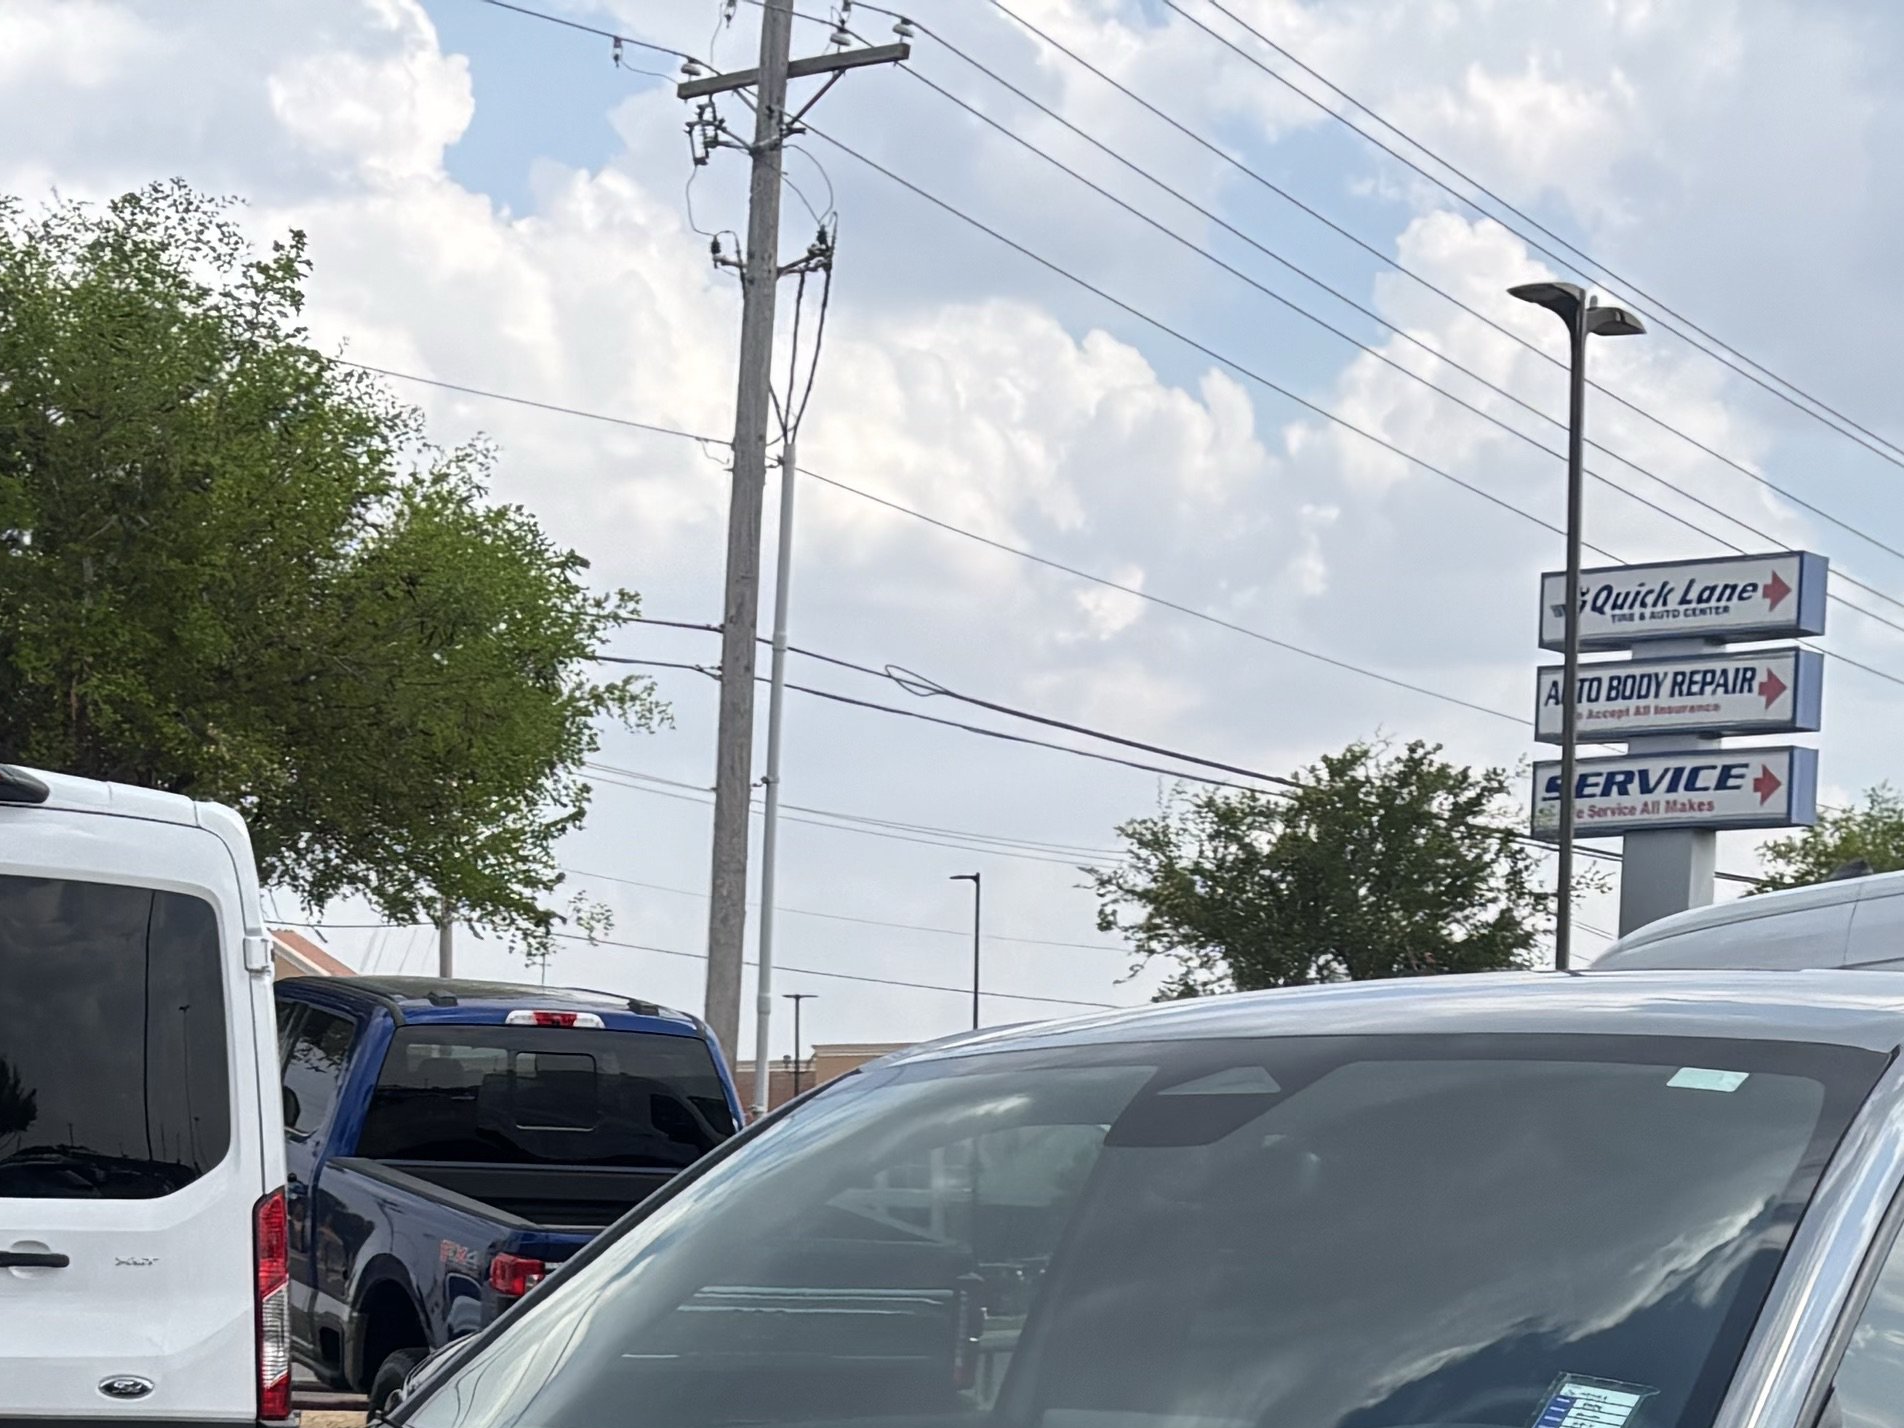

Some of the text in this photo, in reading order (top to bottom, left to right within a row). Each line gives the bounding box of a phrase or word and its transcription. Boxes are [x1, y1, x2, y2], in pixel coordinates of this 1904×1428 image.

[1590, 578, 1758, 615] Quick Lane
[1611, 612, 1635, 624] TIRE
[1649, 609, 1680, 620] AUTO
[1683, 605, 1730, 618] CENTER
[1544, 667, 1756, 706] ATO BODY REPAIR
[1586, 706, 1630, 720] Accept
[1633, 704, 1650, 716] All
[1654, 702, 1720, 715] Insurance
[1542, 763, 1749, 800] SERVICE
[1587, 802, 1636, 819] Service
[1640, 800, 1660, 815] All
[1664, 799, 1714, 814] Makes
